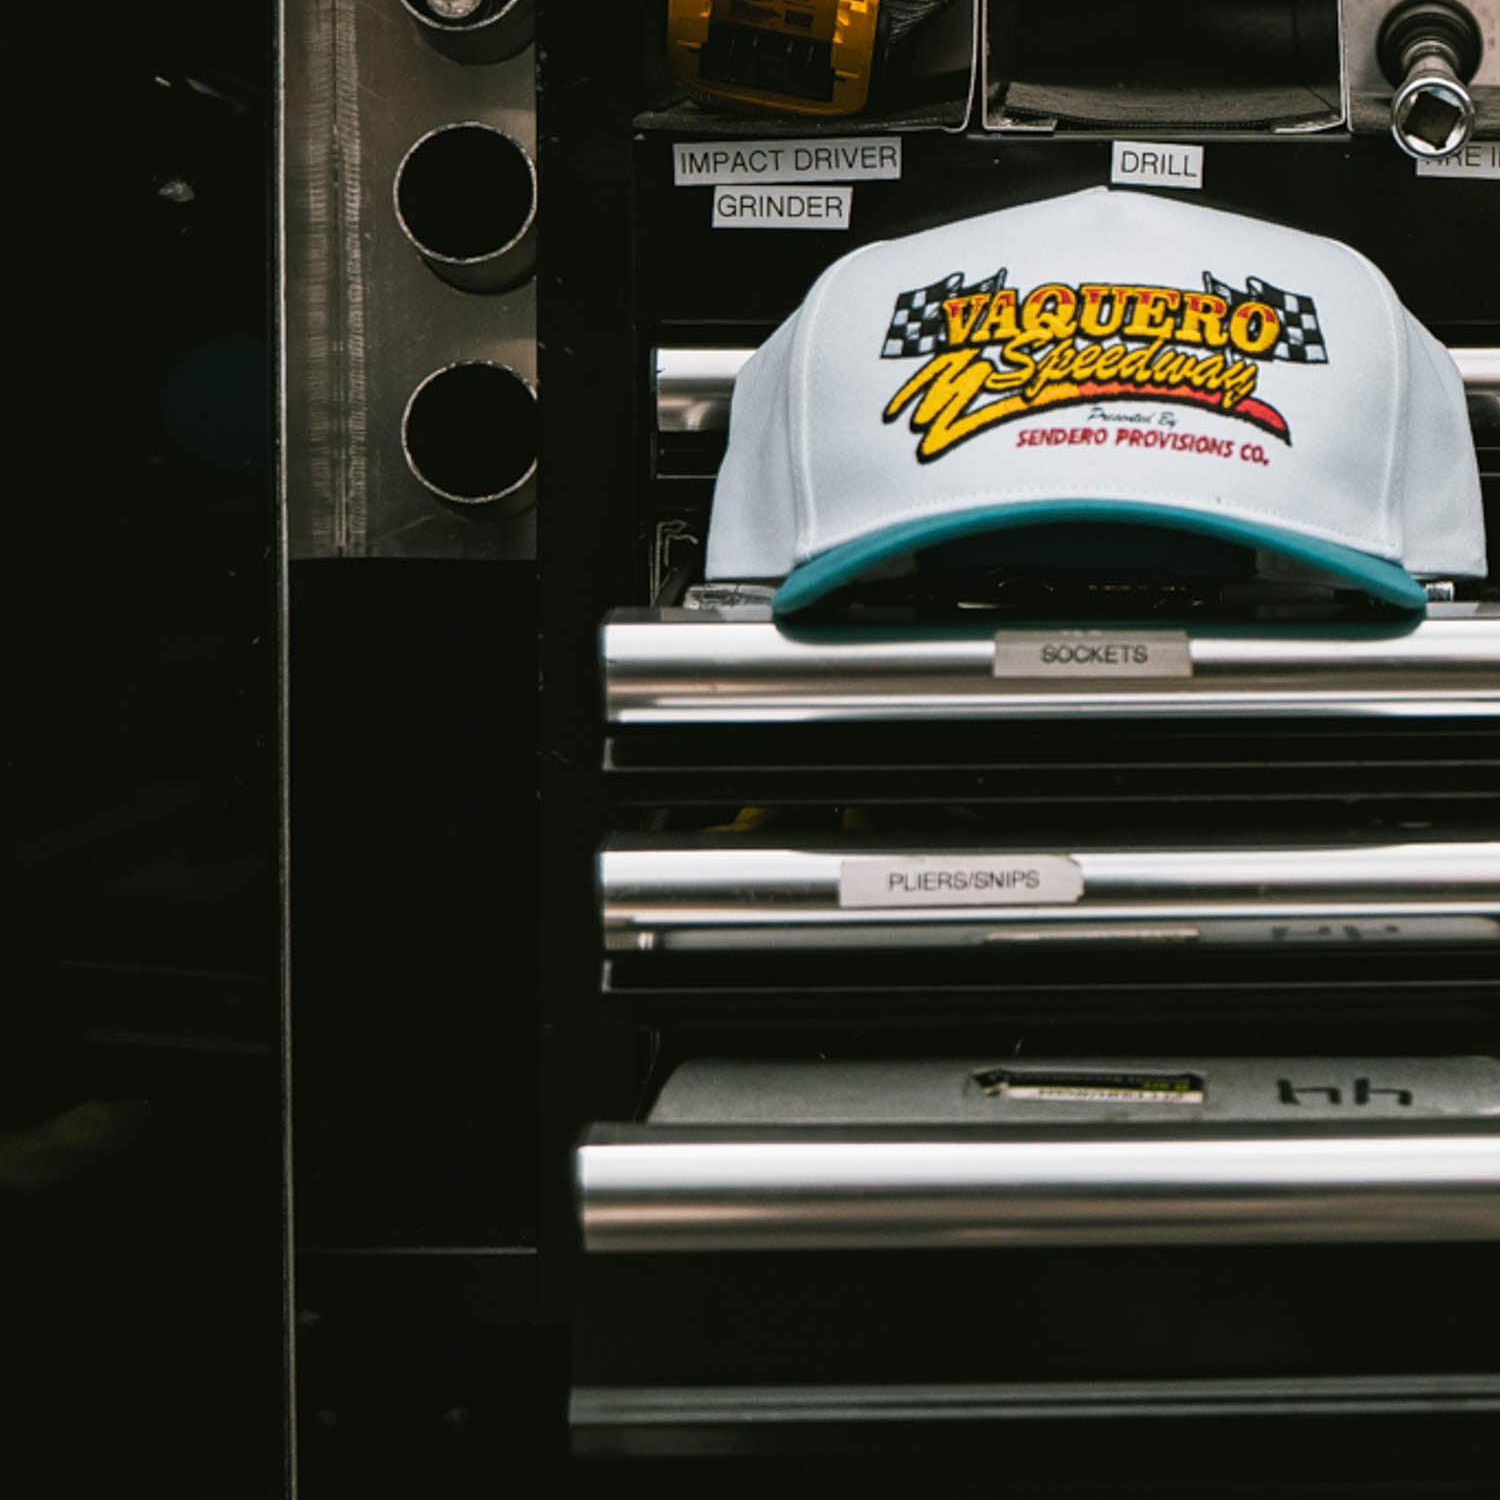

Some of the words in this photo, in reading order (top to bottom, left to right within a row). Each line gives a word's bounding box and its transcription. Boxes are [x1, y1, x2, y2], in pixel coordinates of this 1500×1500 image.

[679, 148, 785, 175] IMPACT
[794, 145, 898, 172] DRIVER
[1120, 150, 1197, 177] DRILL
[1425, 146, 1482, 168] RE
[717, 194, 843, 219] GRINDER
[942, 282, 1282, 354] VAQUERO
[987, 330, 1259, 408] Speedway
[1087, 406, 1154, 423] Presented
[1158, 411, 1178, 428] By
[1016, 427, 1107, 448] SENDERO
[1115, 429, 1235, 458] PROVISIONS
[1240, 443, 1270, 466] CO.
[1041, 643, 1148, 663] SOCKETS
[889, 869, 1040, 892] PLIERS/SNIPS
